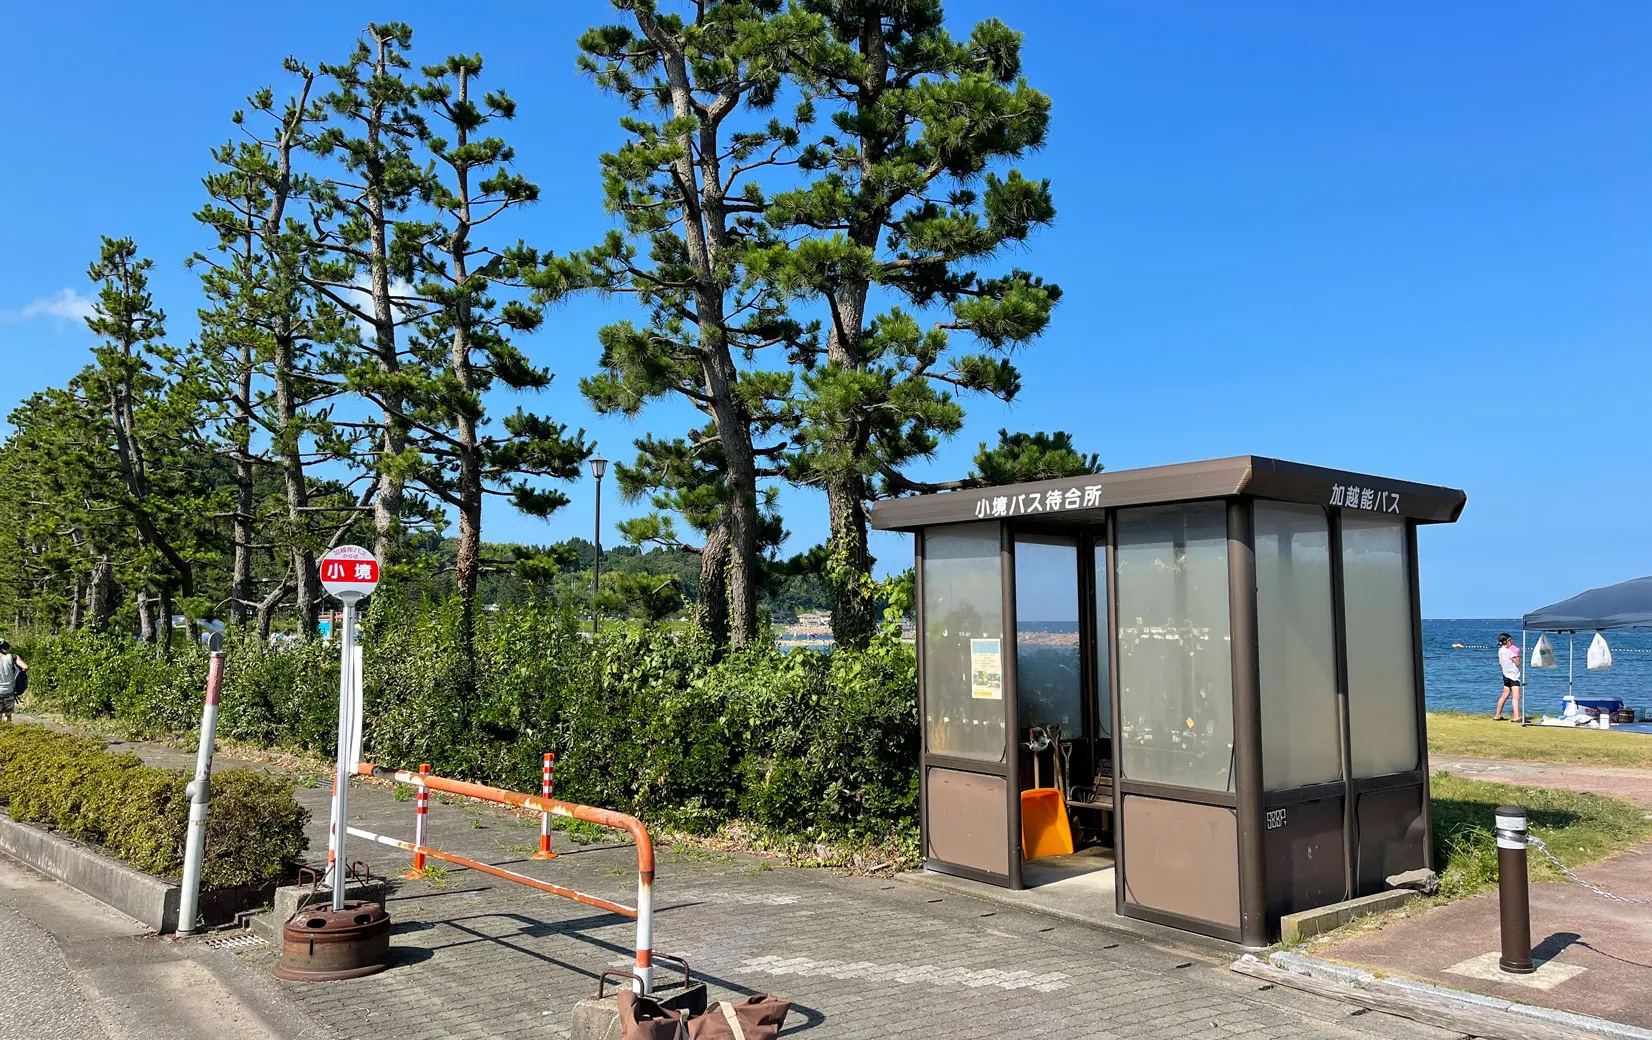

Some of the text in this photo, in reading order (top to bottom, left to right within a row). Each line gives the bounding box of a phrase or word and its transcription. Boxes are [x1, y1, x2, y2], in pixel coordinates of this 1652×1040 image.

[975, 485, 1102, 518] 小境バス待合所
[1329, 483, 1400, 514] 加越能バス
